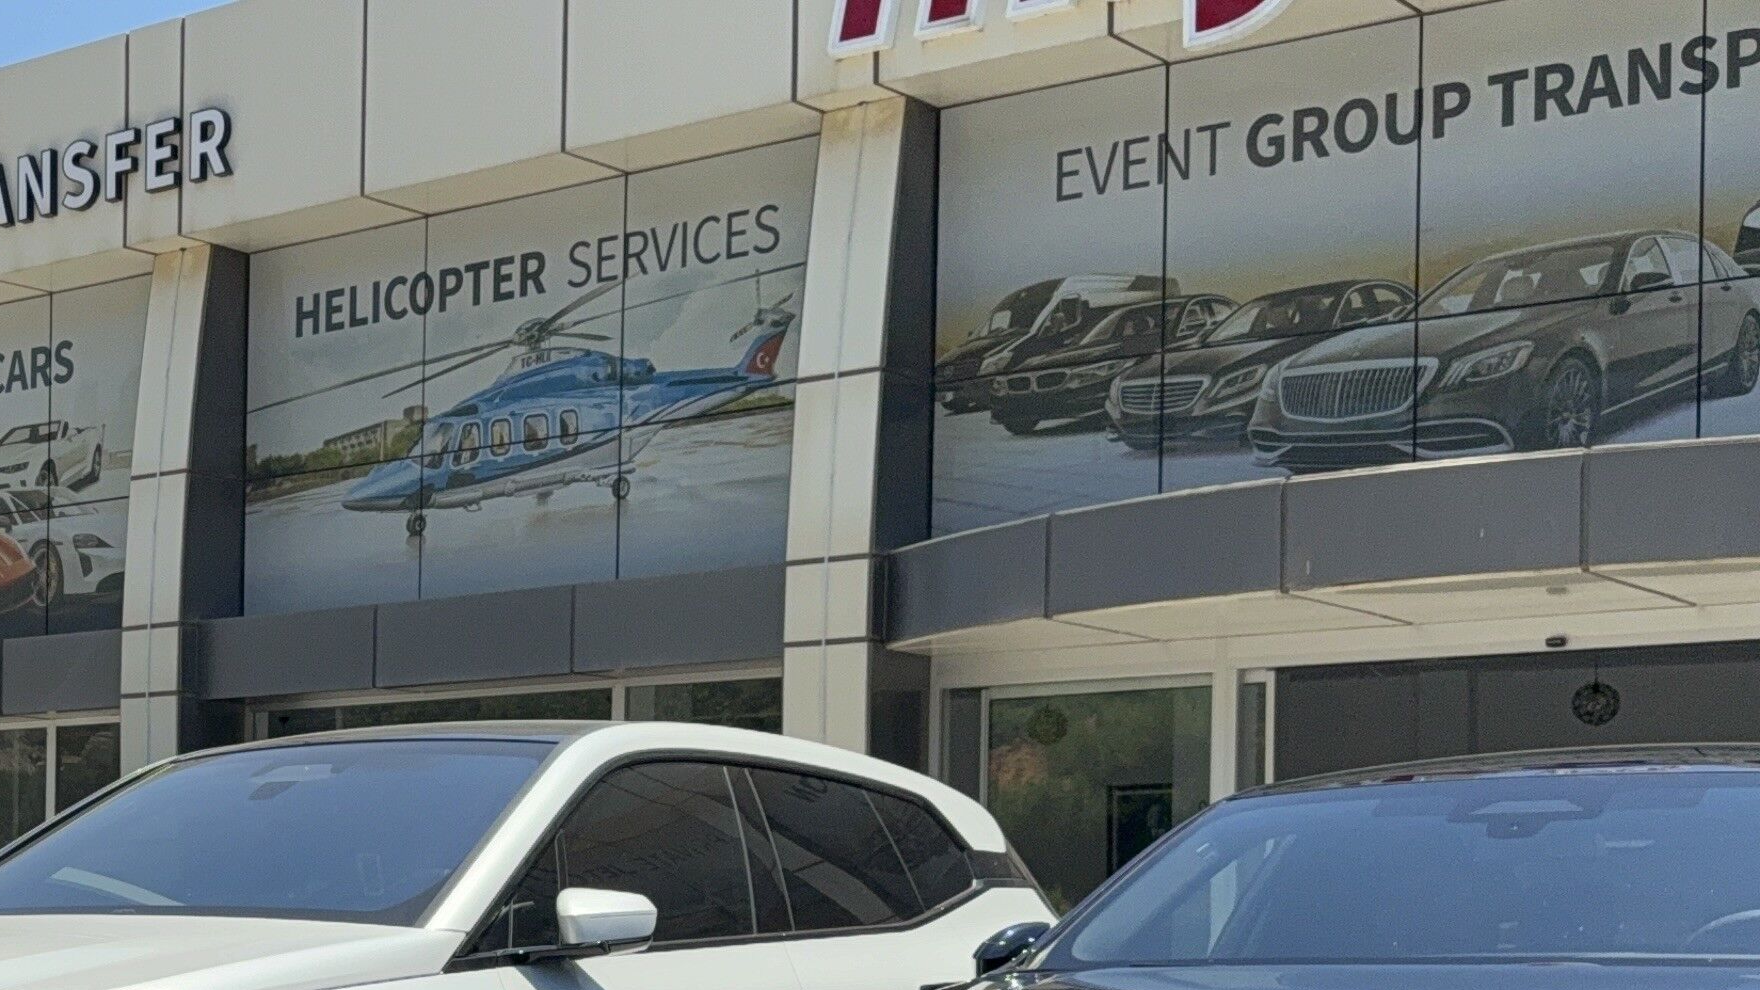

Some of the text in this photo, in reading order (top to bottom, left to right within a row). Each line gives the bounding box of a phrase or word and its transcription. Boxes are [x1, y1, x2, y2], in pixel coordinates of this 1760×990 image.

[1055, 121, 1231, 202] EVENT
[1246, 80, 1472, 168] GROUP
[295, 205, 781, 338] HELICOPTER SERVICES
